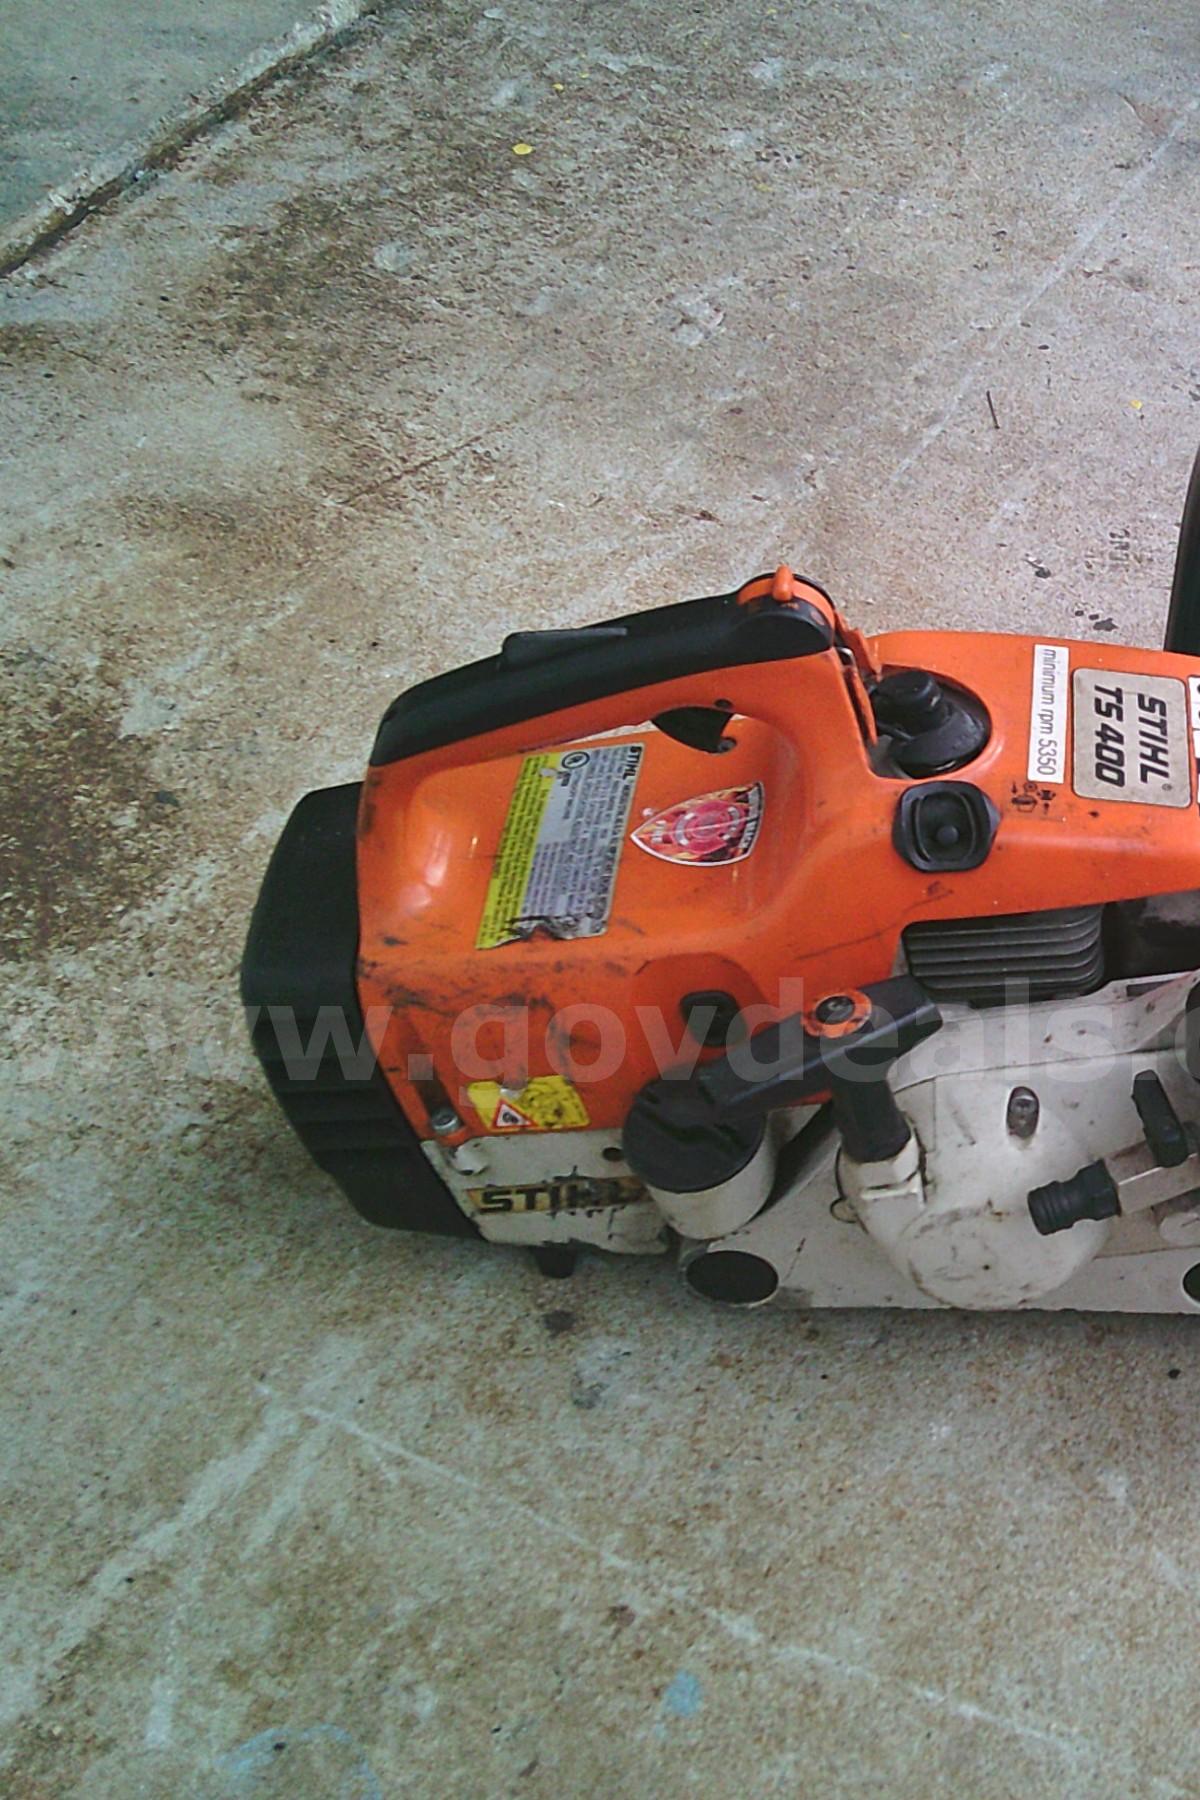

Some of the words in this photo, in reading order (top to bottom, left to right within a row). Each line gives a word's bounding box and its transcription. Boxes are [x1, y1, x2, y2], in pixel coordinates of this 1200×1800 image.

[1040, 648, 1057, 705] minimum
[1037, 708, 1055, 735] rpm
[1094, 684, 1123, 722] TS
[1036, 738, 1058, 775] 5350
[1095, 722, 1126, 787] 400
[1137, 693, 1170, 783] STIHL
[622, 745, 643, 780] STIHL
